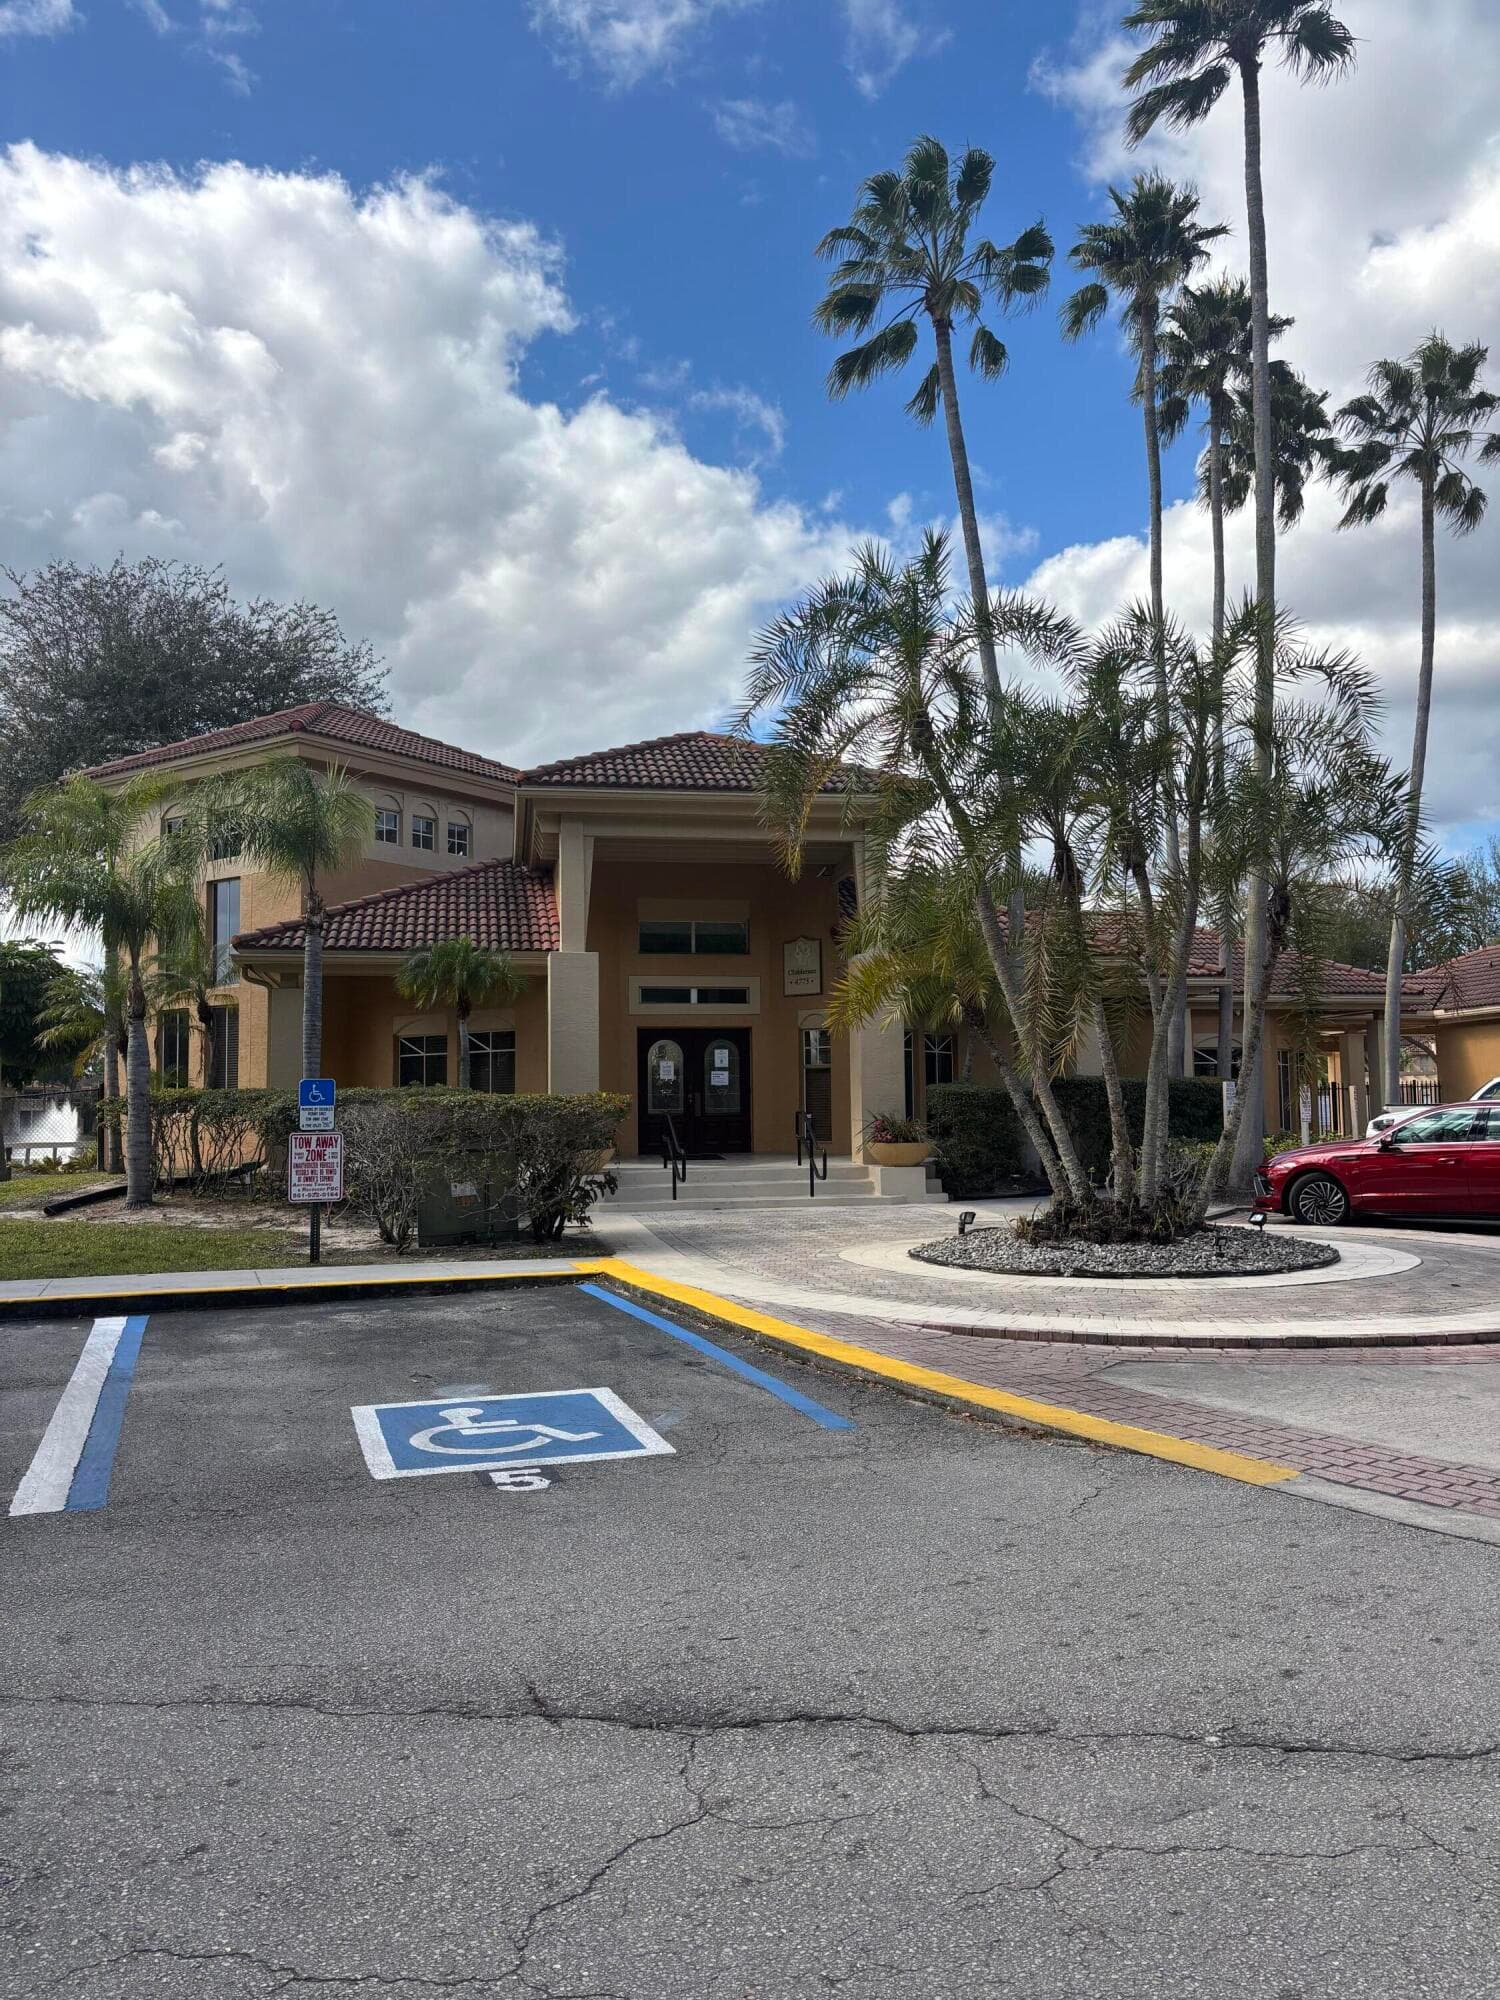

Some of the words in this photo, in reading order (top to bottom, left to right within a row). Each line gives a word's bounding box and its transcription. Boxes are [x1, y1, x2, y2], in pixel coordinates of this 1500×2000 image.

[293, 1136, 312, 1149] TOW
[315, 1136, 339, 1149] AWAY
[305, 1149, 327, 1161] ZONE
[489, 1468, 551, 1490] 5
